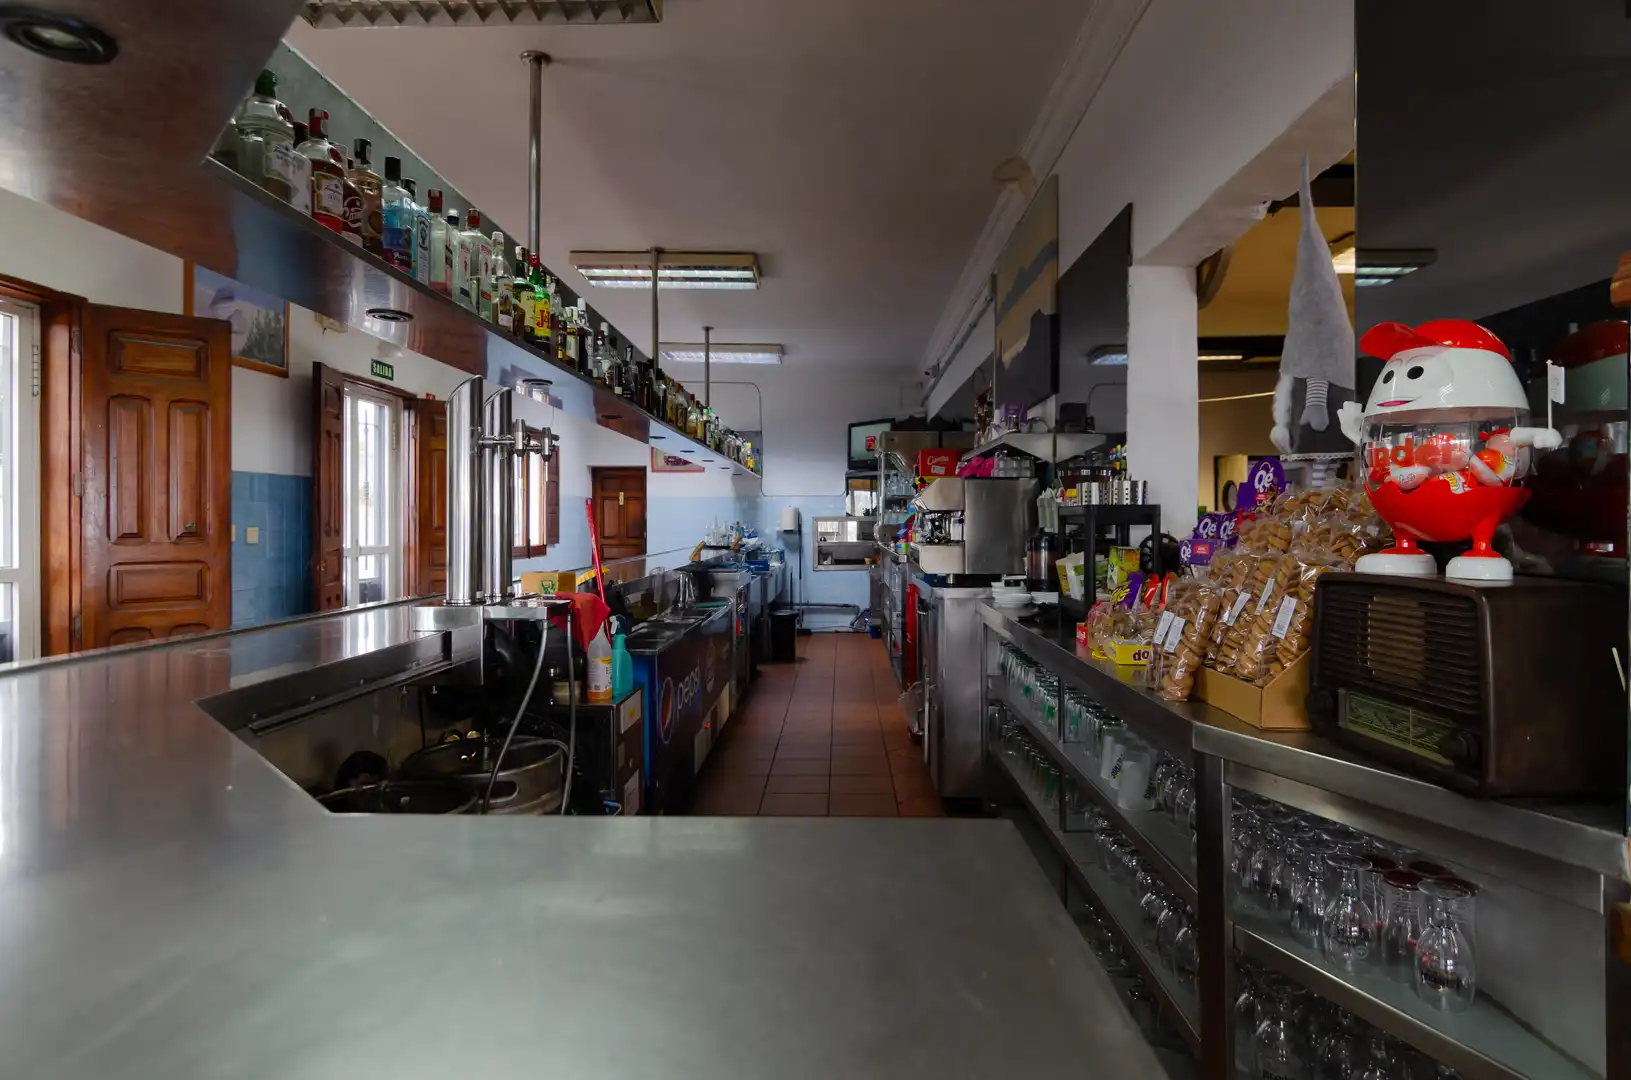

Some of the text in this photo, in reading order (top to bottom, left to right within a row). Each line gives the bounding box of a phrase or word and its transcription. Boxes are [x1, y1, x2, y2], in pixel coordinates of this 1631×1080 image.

[373, 362, 392, 377] SALIDA
[1255, 467, 1273, 493] Qé
[1220, 516, 1237, 541] Qé
[1181, 544, 1191, 561] Qé
[677, 660, 700, 722] pepsi
